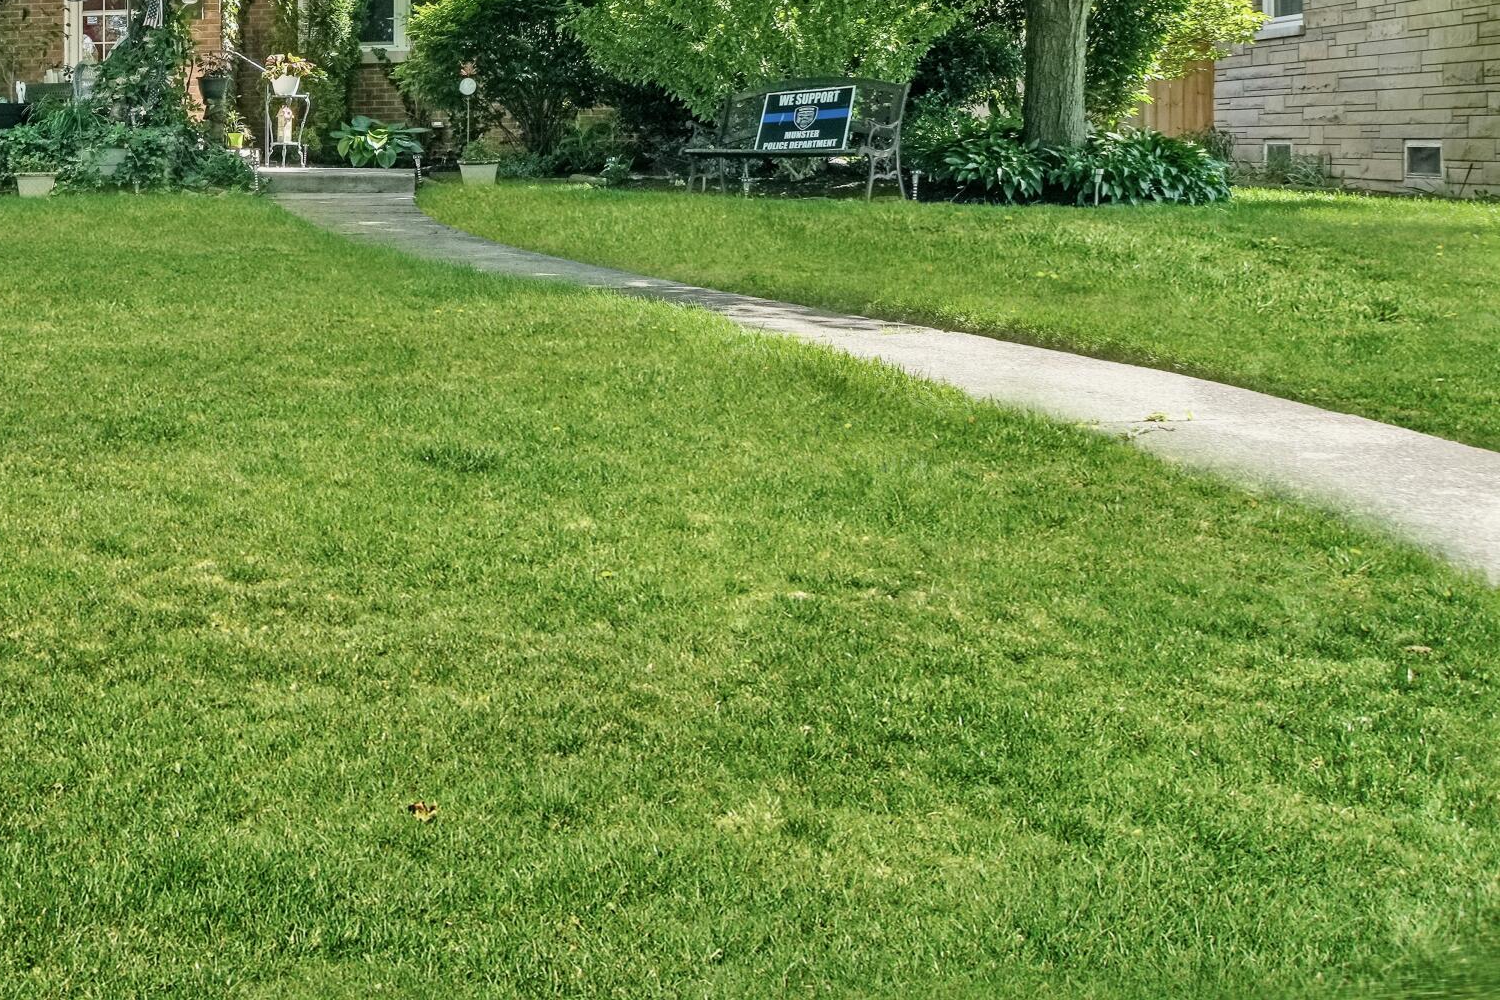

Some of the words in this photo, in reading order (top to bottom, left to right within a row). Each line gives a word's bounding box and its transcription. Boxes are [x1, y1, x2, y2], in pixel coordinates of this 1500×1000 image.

[779, 94, 795, 106] WE
[795, 90, 840, 105] SUPPORT
[784, 130, 820, 139] MUNSTER
[763, 141, 788, 150] POLICE
[789, 139, 837, 149] DEPARTMENT
